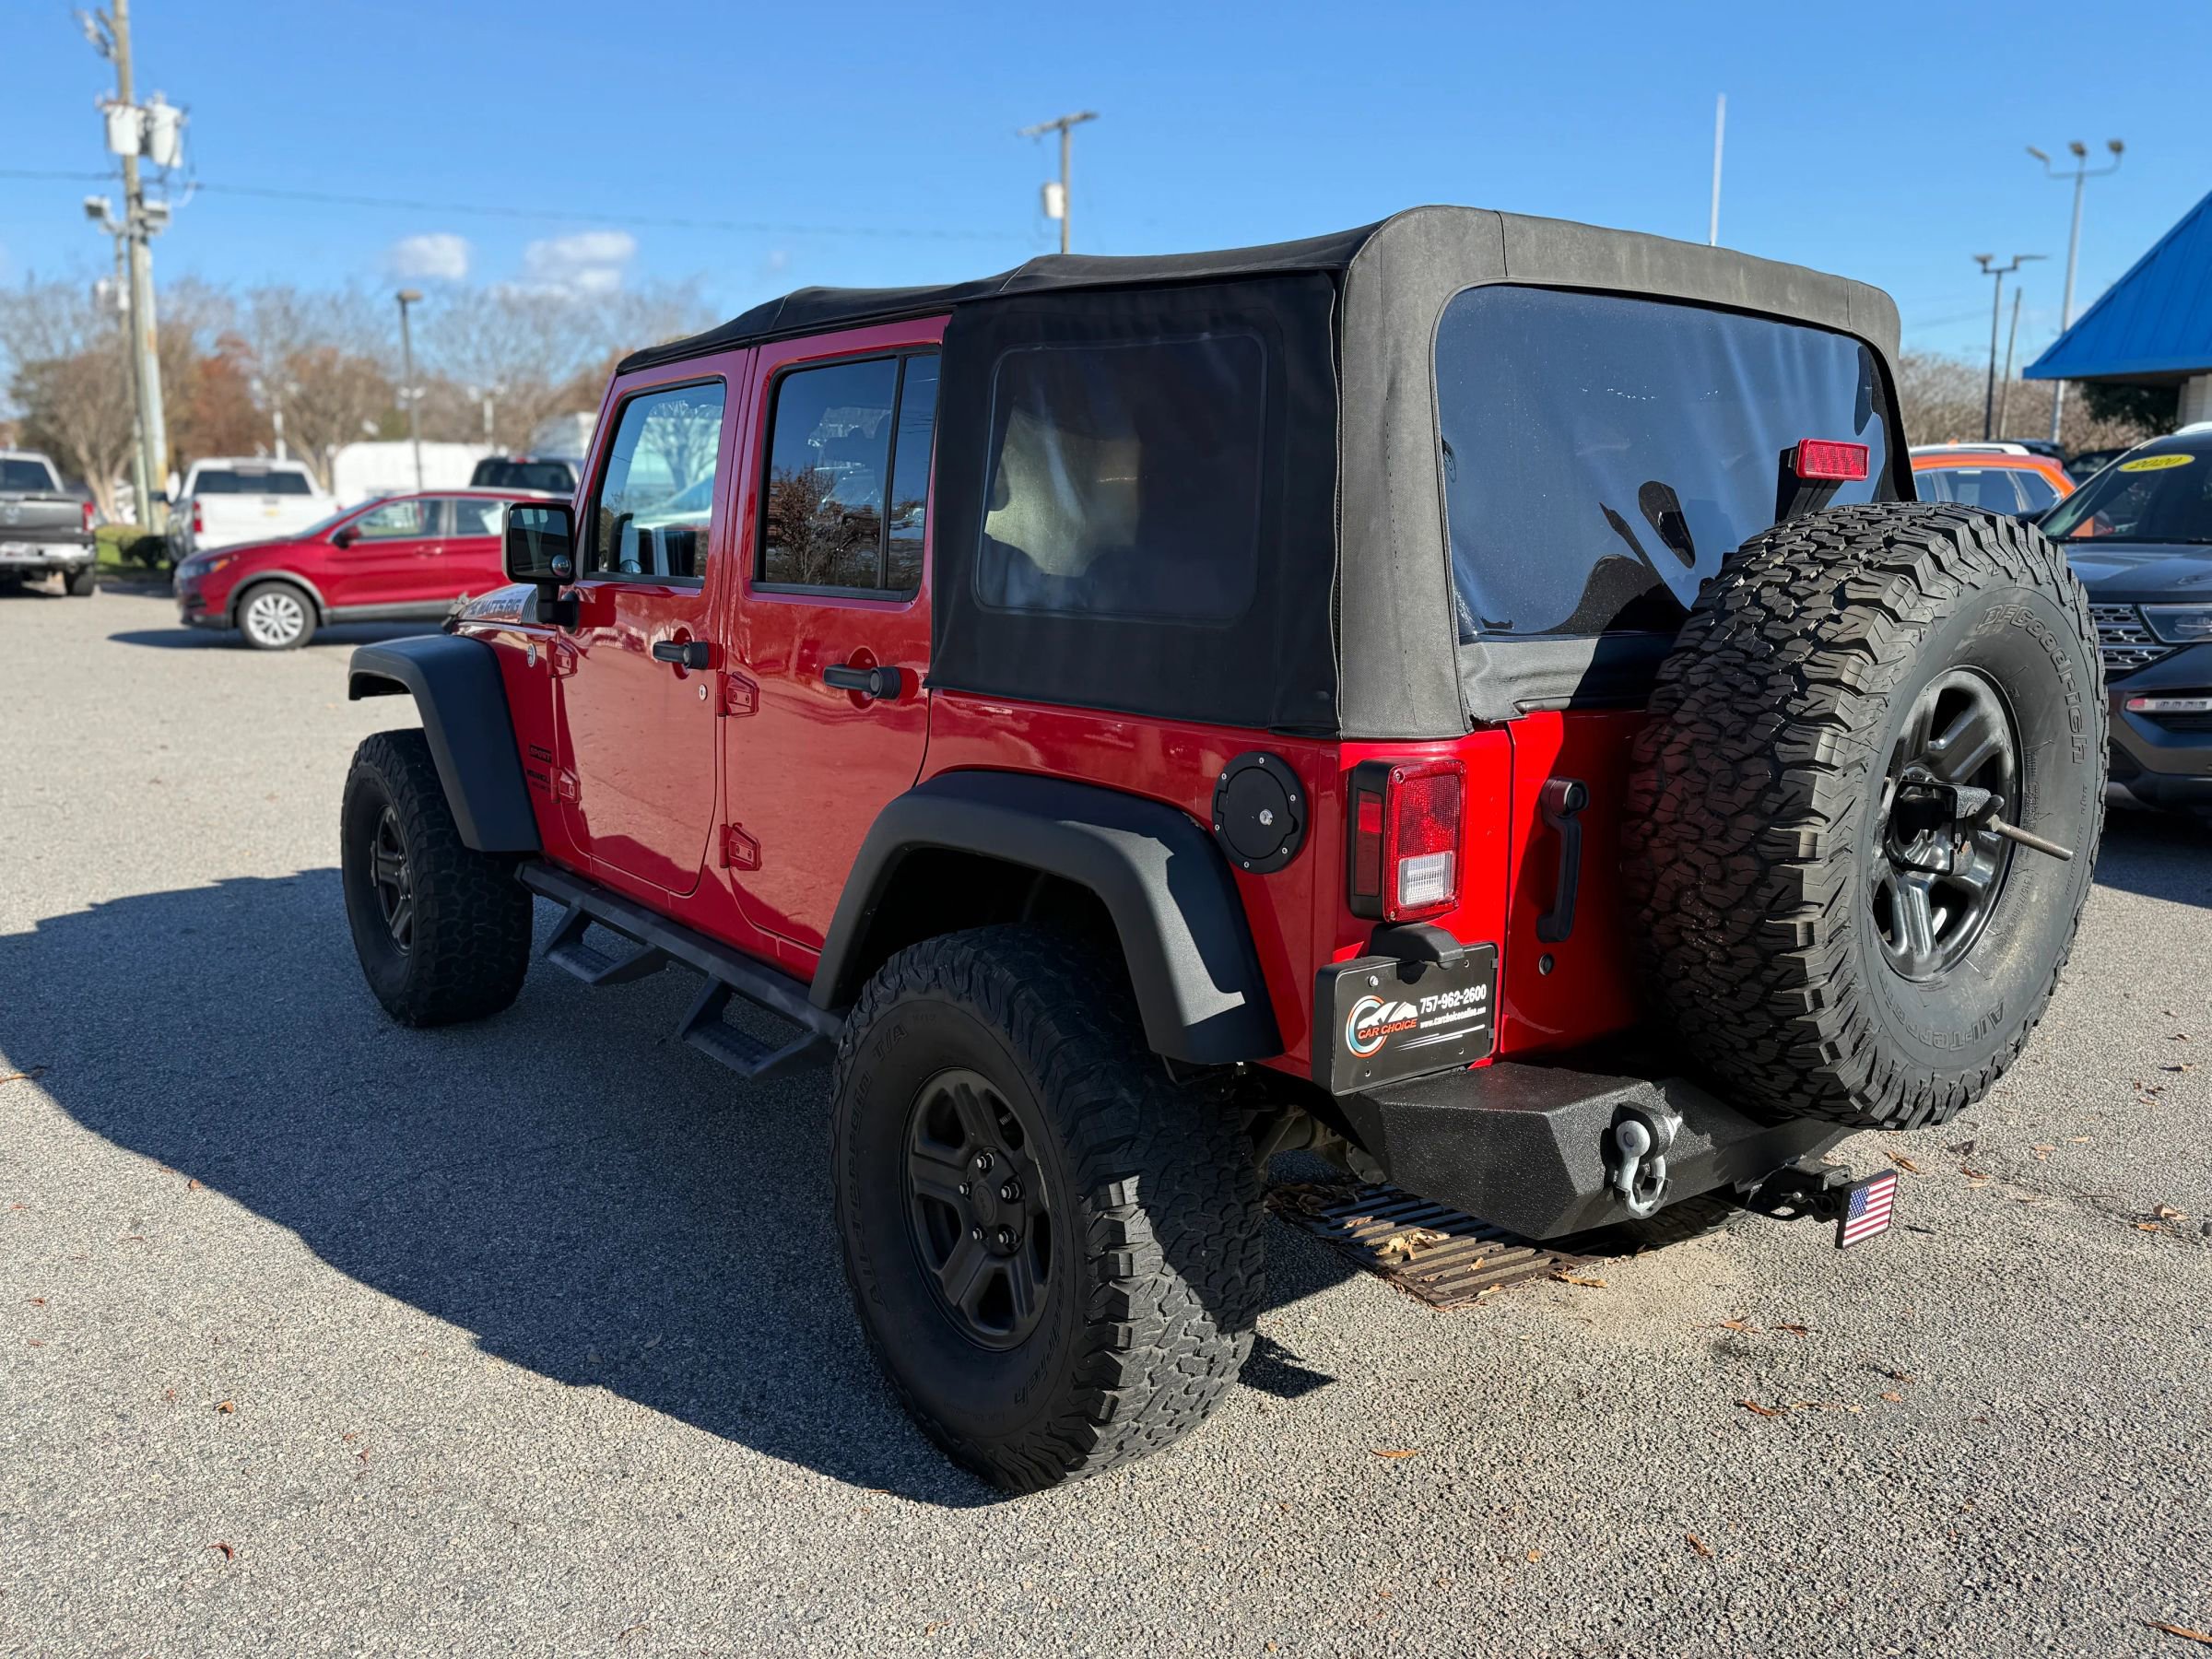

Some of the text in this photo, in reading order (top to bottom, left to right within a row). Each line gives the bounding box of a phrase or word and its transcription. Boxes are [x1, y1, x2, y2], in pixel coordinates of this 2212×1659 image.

[1420, 983, 1487, 1015] 757-962-2600
[872, 1023, 910, 1065] T/A
[1358, 1018, 1418, 1041] CAR CHOICE
